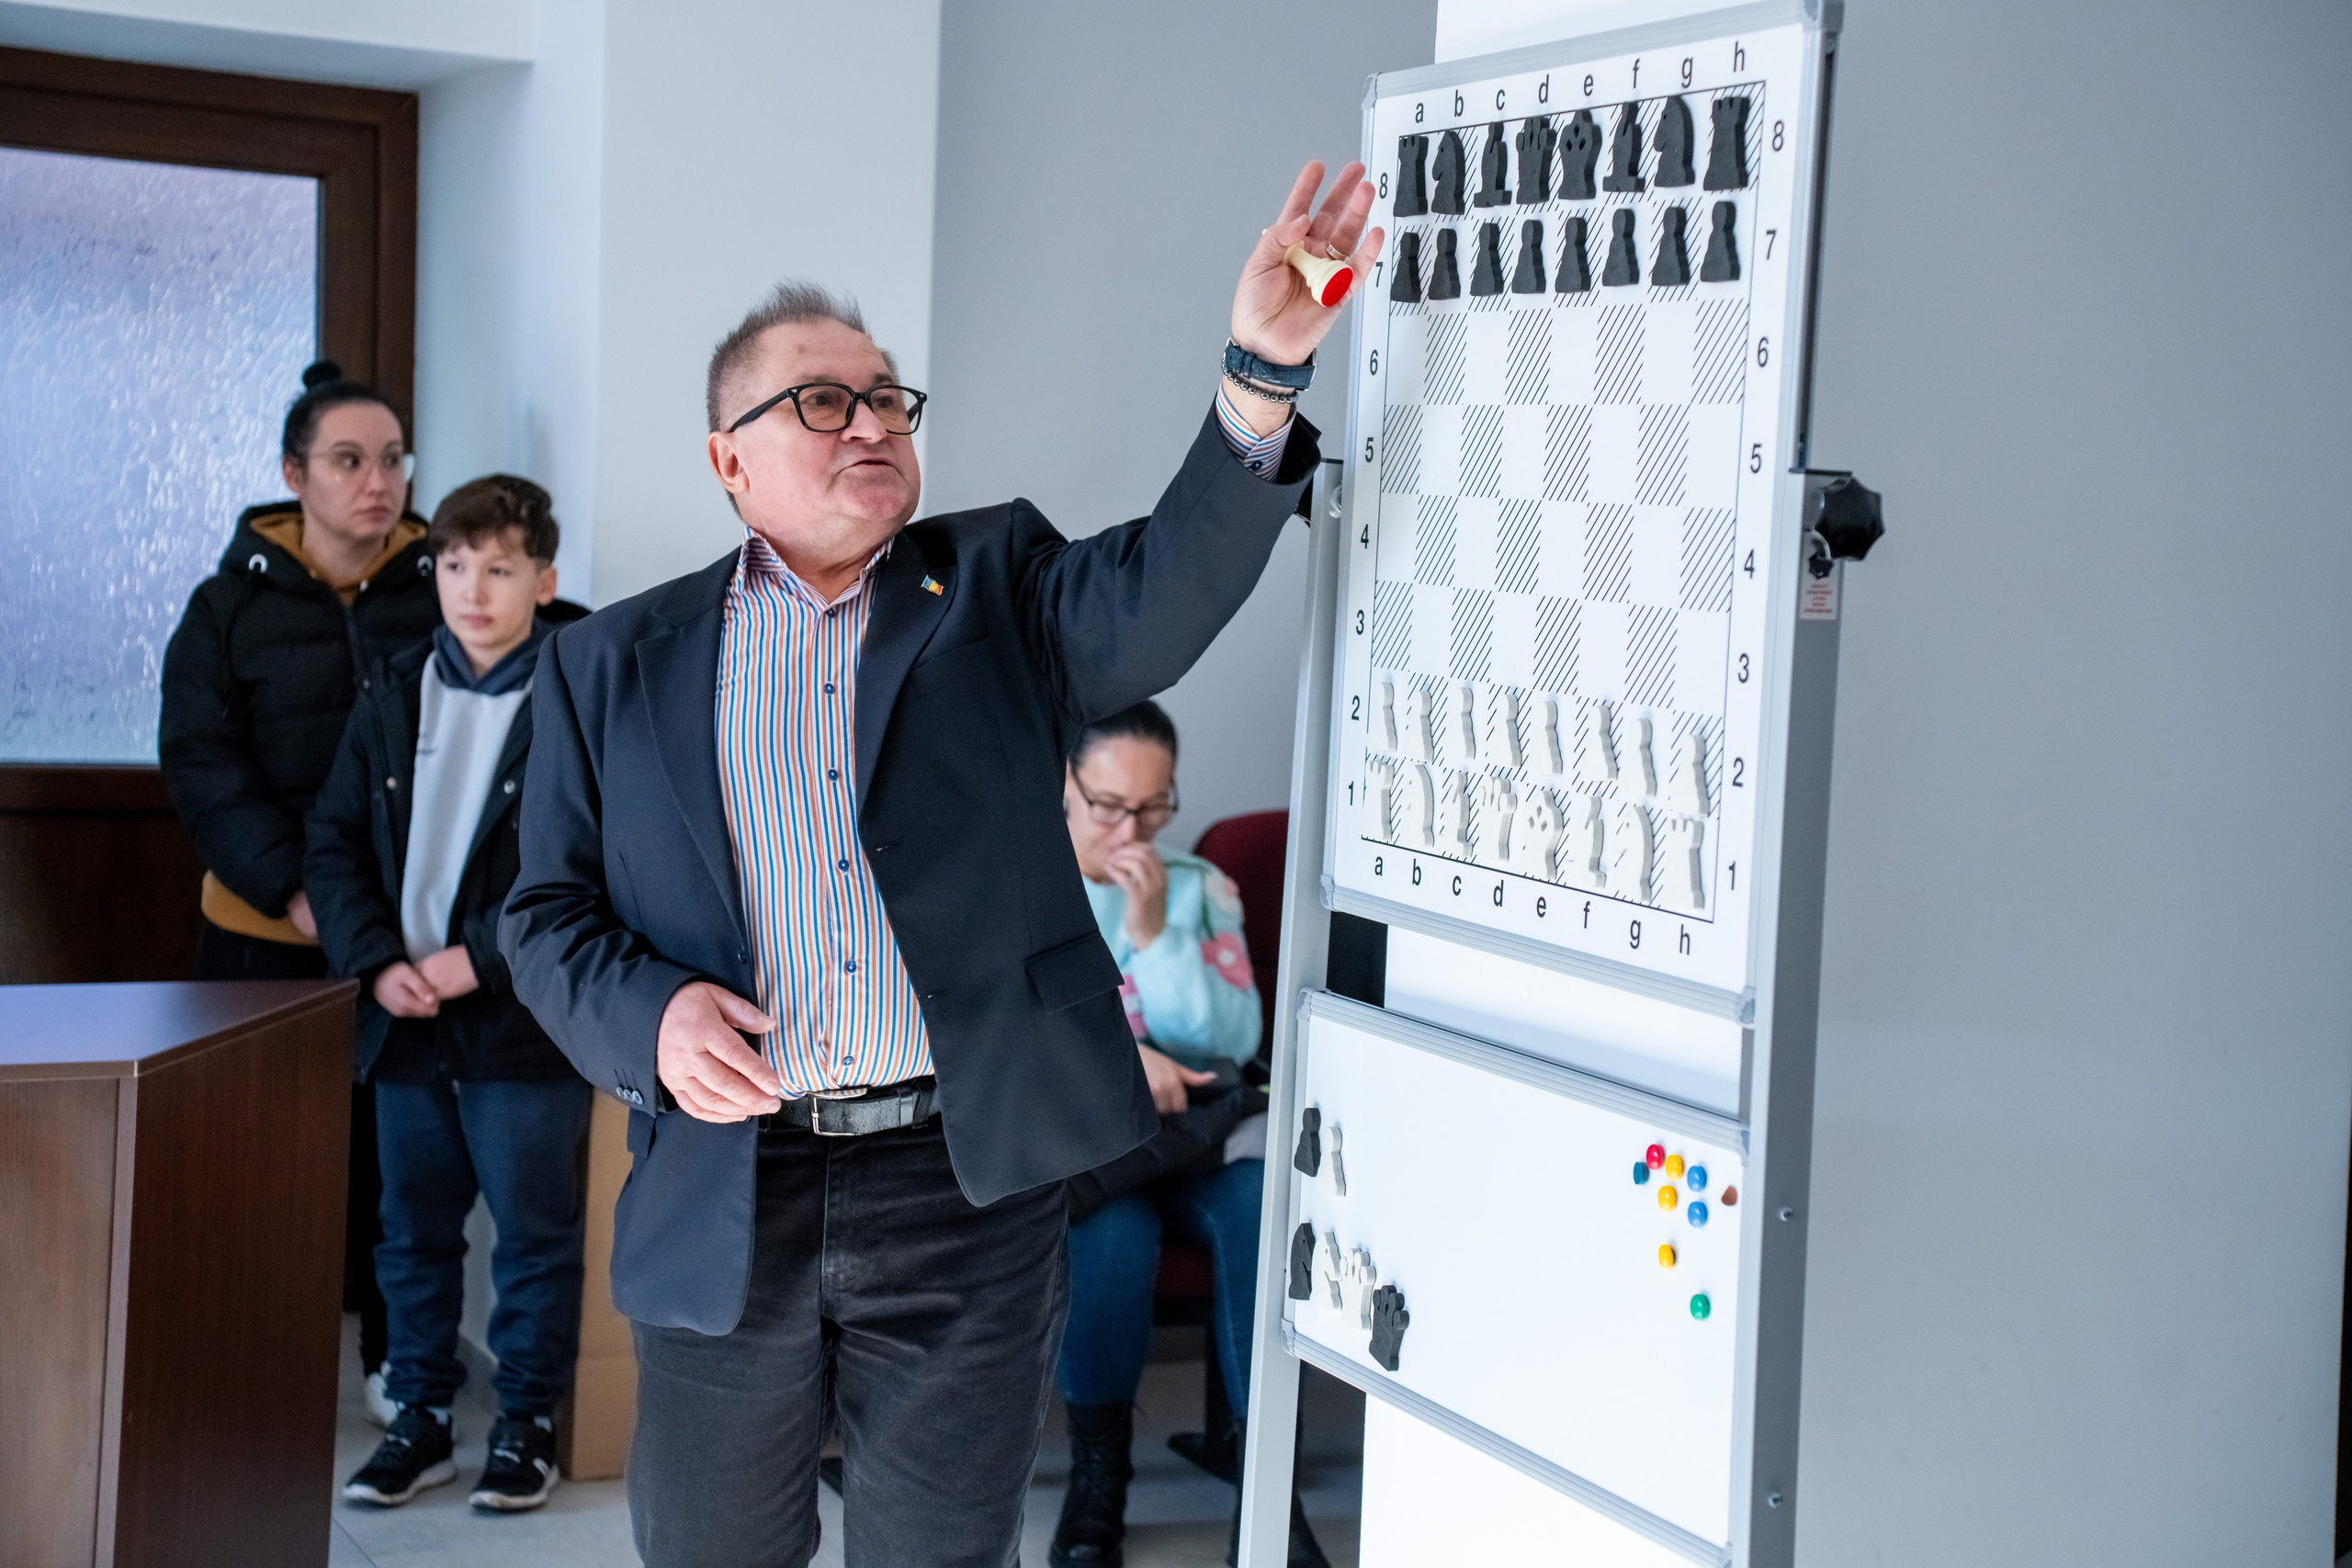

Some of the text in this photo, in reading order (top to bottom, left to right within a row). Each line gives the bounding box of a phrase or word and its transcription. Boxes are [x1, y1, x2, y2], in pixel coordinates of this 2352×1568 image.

[1415, 40, 1746, 124] a b c d e f g h
[1771, 119, 1784, 152] 8
[1378, 172, 1388, 199] 8
[1766, 229, 1777, 261] 7
[1374, 261, 1384, 288] 7
[1369, 349, 1379, 377] 6
[1757, 336, 1769, 368] 6
[1364, 436, 1374, 464] 5
[1749, 443, 1762, 474] 5
[1360, 524, 1370, 549] 4
[1743, 548, 1755, 579] 4
[1355, 609, 1365, 636] 3
[1737, 652, 1749, 684] 3
[1351, 694, 1361, 721] 2
[1732, 756, 1745, 788] 2
[1348, 781, 1354, 807] 1
[1728, 861, 1736, 891] 1
[1374, 856, 1690, 956] a b c d e f g h
